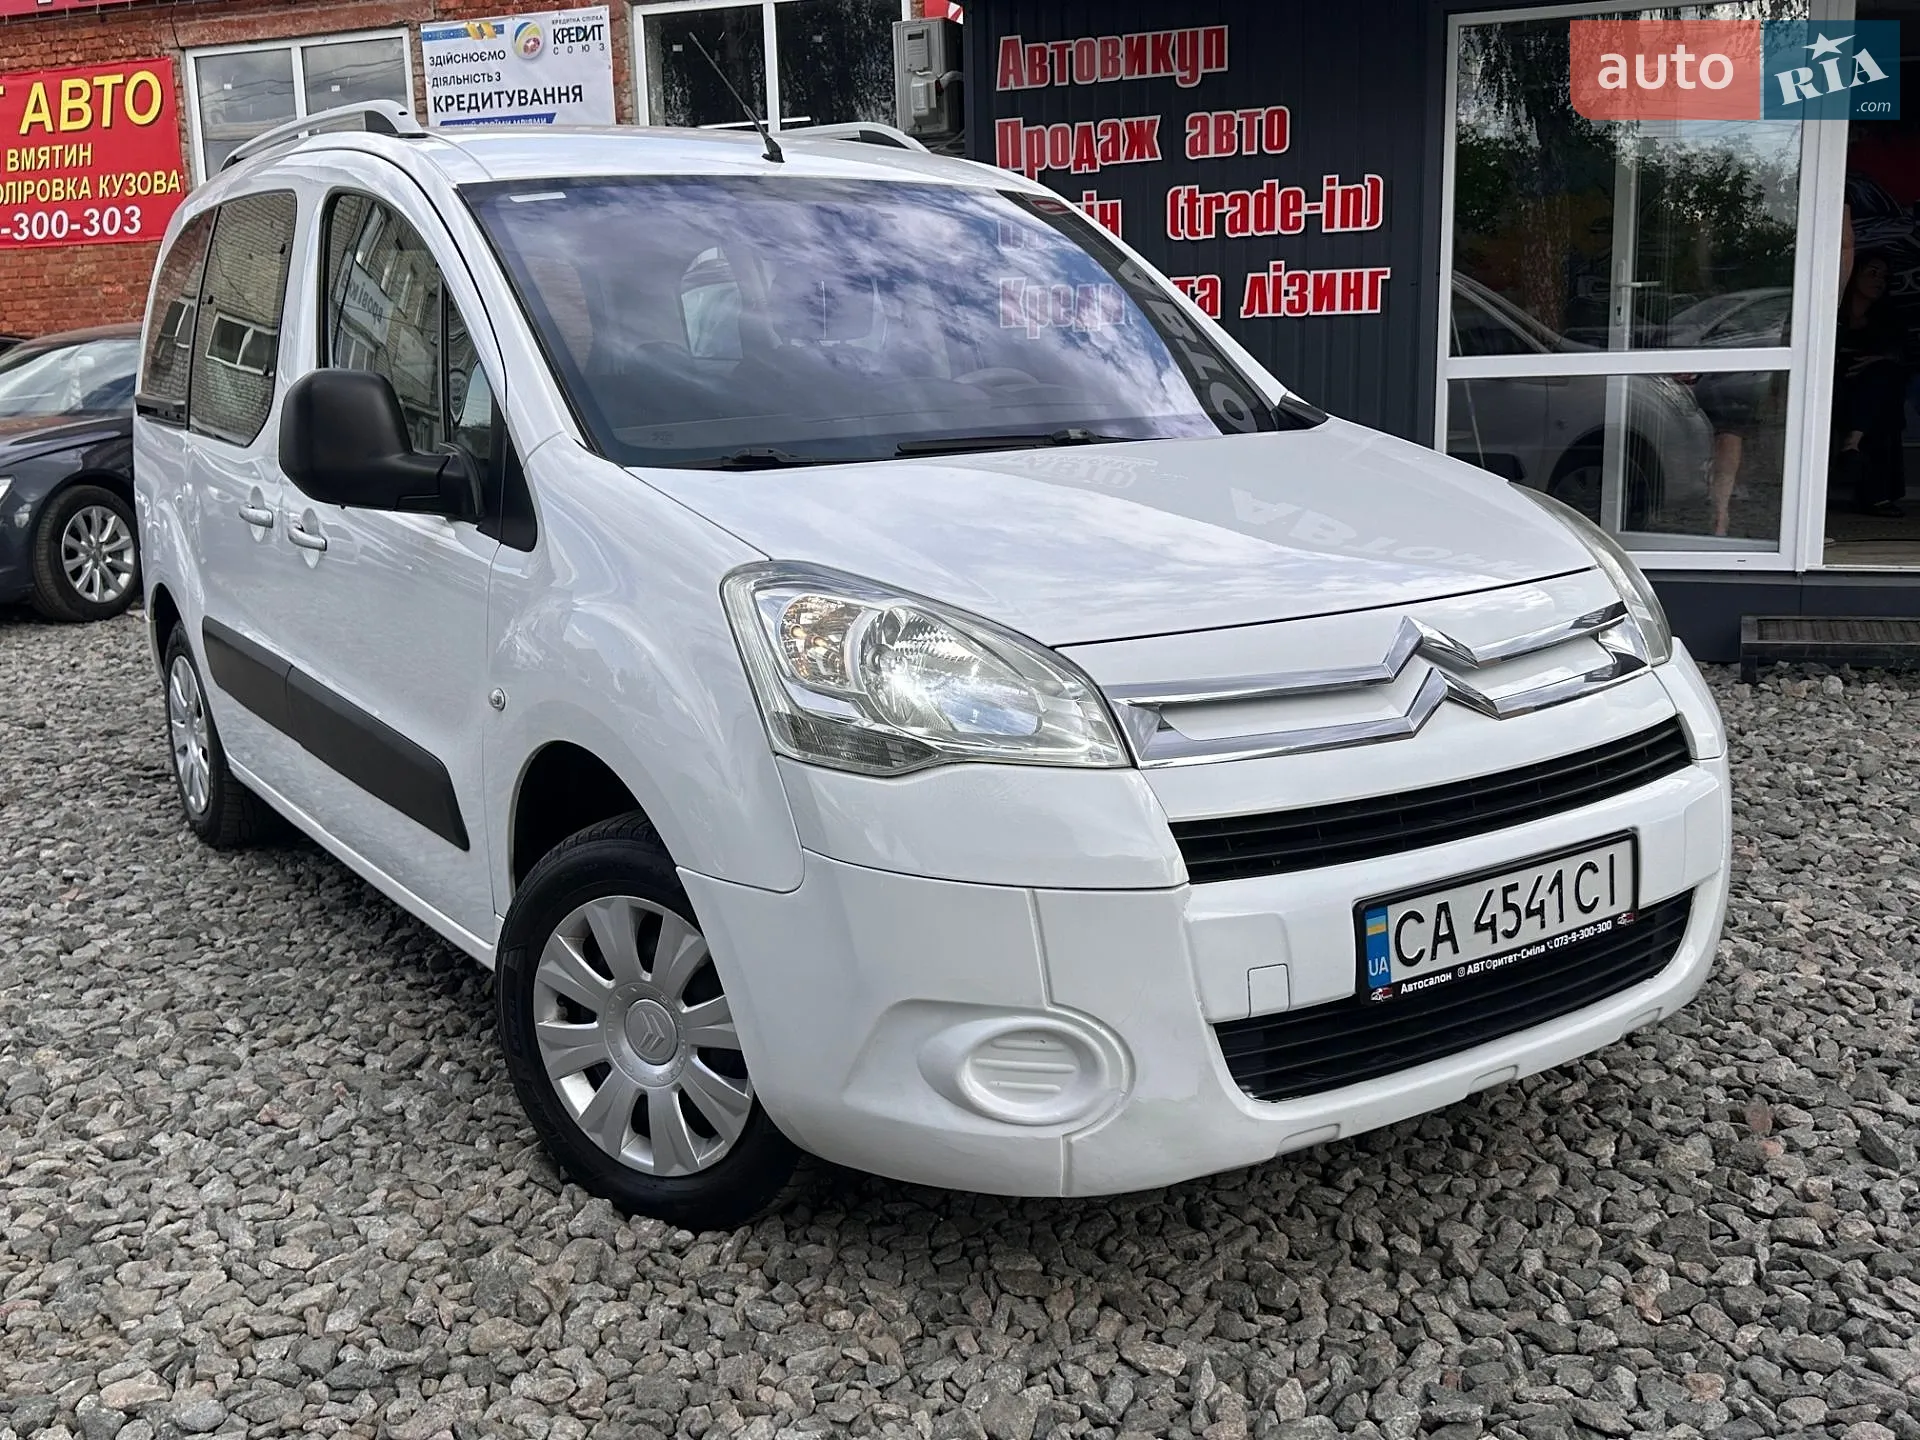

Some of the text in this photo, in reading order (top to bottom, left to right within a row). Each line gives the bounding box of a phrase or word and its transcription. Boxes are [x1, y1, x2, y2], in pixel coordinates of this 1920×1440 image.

[429, 49, 506, 67] ЗДІЙСНЮЄМО
[432, 73, 491, 88] ДІЯЛЬНІСТЬ
[996, 25, 1228, 90] Автовикуп
[19, 70, 163, 136] АВТО
[433, 85, 583, 113] КРЕДИТУВАННЯ
[7, 143, 92, 172] ВМЯТИН
[995, 106, 1290, 180] Продаж авто
[0, 170, 181, 204] ЛІРОВКА КУЗОВА
[1167, 174, 1384, 241] (trade-in)
[1, 205, 141, 241] -300-303
[999, 277, 1133, 339] Креди
[1240, 260, 1391, 319] лізинг
[1394, 901, 1460, 966] CA
[1474, 869, 1564, 944] 4541
[1368, 956, 1389, 976] UA
[1401, 972, 1452, 994] Автосалон
[1553, 920, 1613, 948] 073-9-300-300
